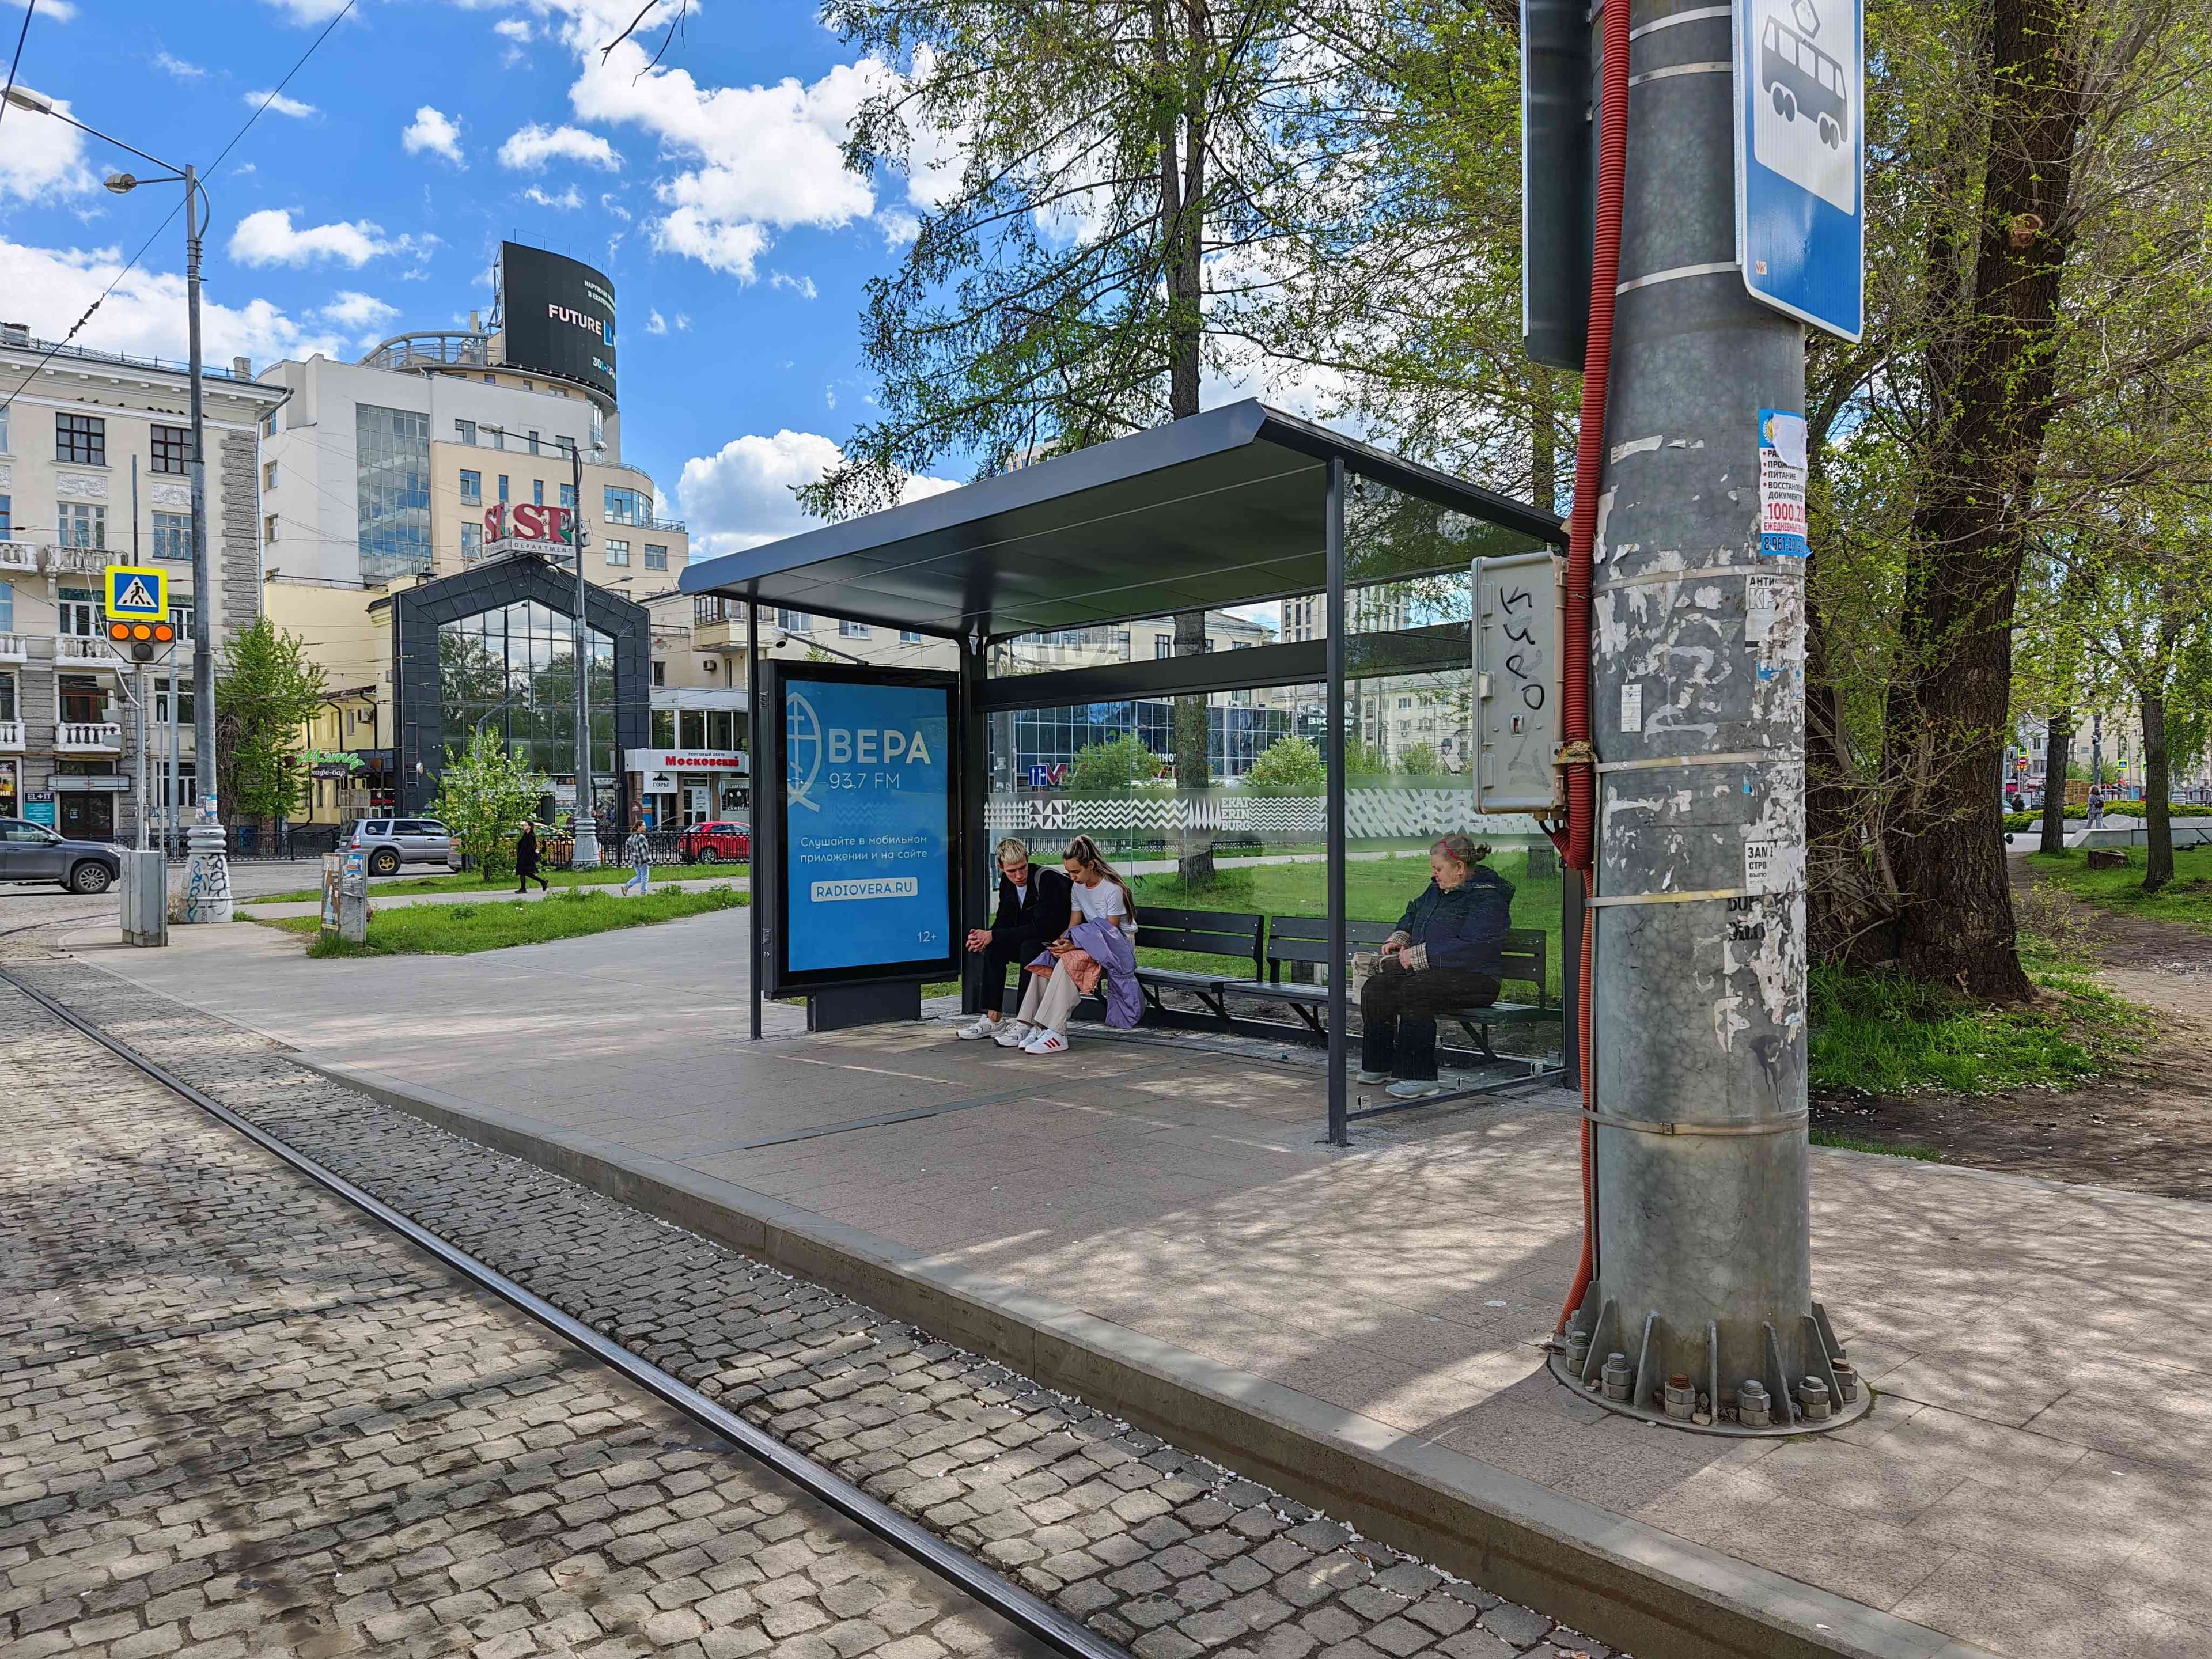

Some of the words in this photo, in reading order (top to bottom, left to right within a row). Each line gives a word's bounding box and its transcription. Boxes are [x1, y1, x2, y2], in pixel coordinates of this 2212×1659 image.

[548, 304, 602, 336] FUTURE
[1768, 471, 1797, 480] ПИТАНИЕ
[514, 542, 573, 554] DEPARTMENT
[829, 728, 931, 764] ВЕРА
[311, 768, 346, 777] кафе-бар
[830, 772, 867, 789] 93.7
[874, 772, 900, 789] FM
[1221, 797, 1249, 808] EKAT
[1221, 808, 1250, 819] ERIN
[1221, 820, 1250, 831] BURG
[800, 836, 856, 849] Слушайте
[868, 834, 927, 845] мобильном
[800, 853, 868, 865] приложении
[881, 851, 895, 859] на
[897, 849, 929, 859] сайте
[816, 881, 913, 898] RADIOVERA.RU
[916, 930, 938, 943] 12+
